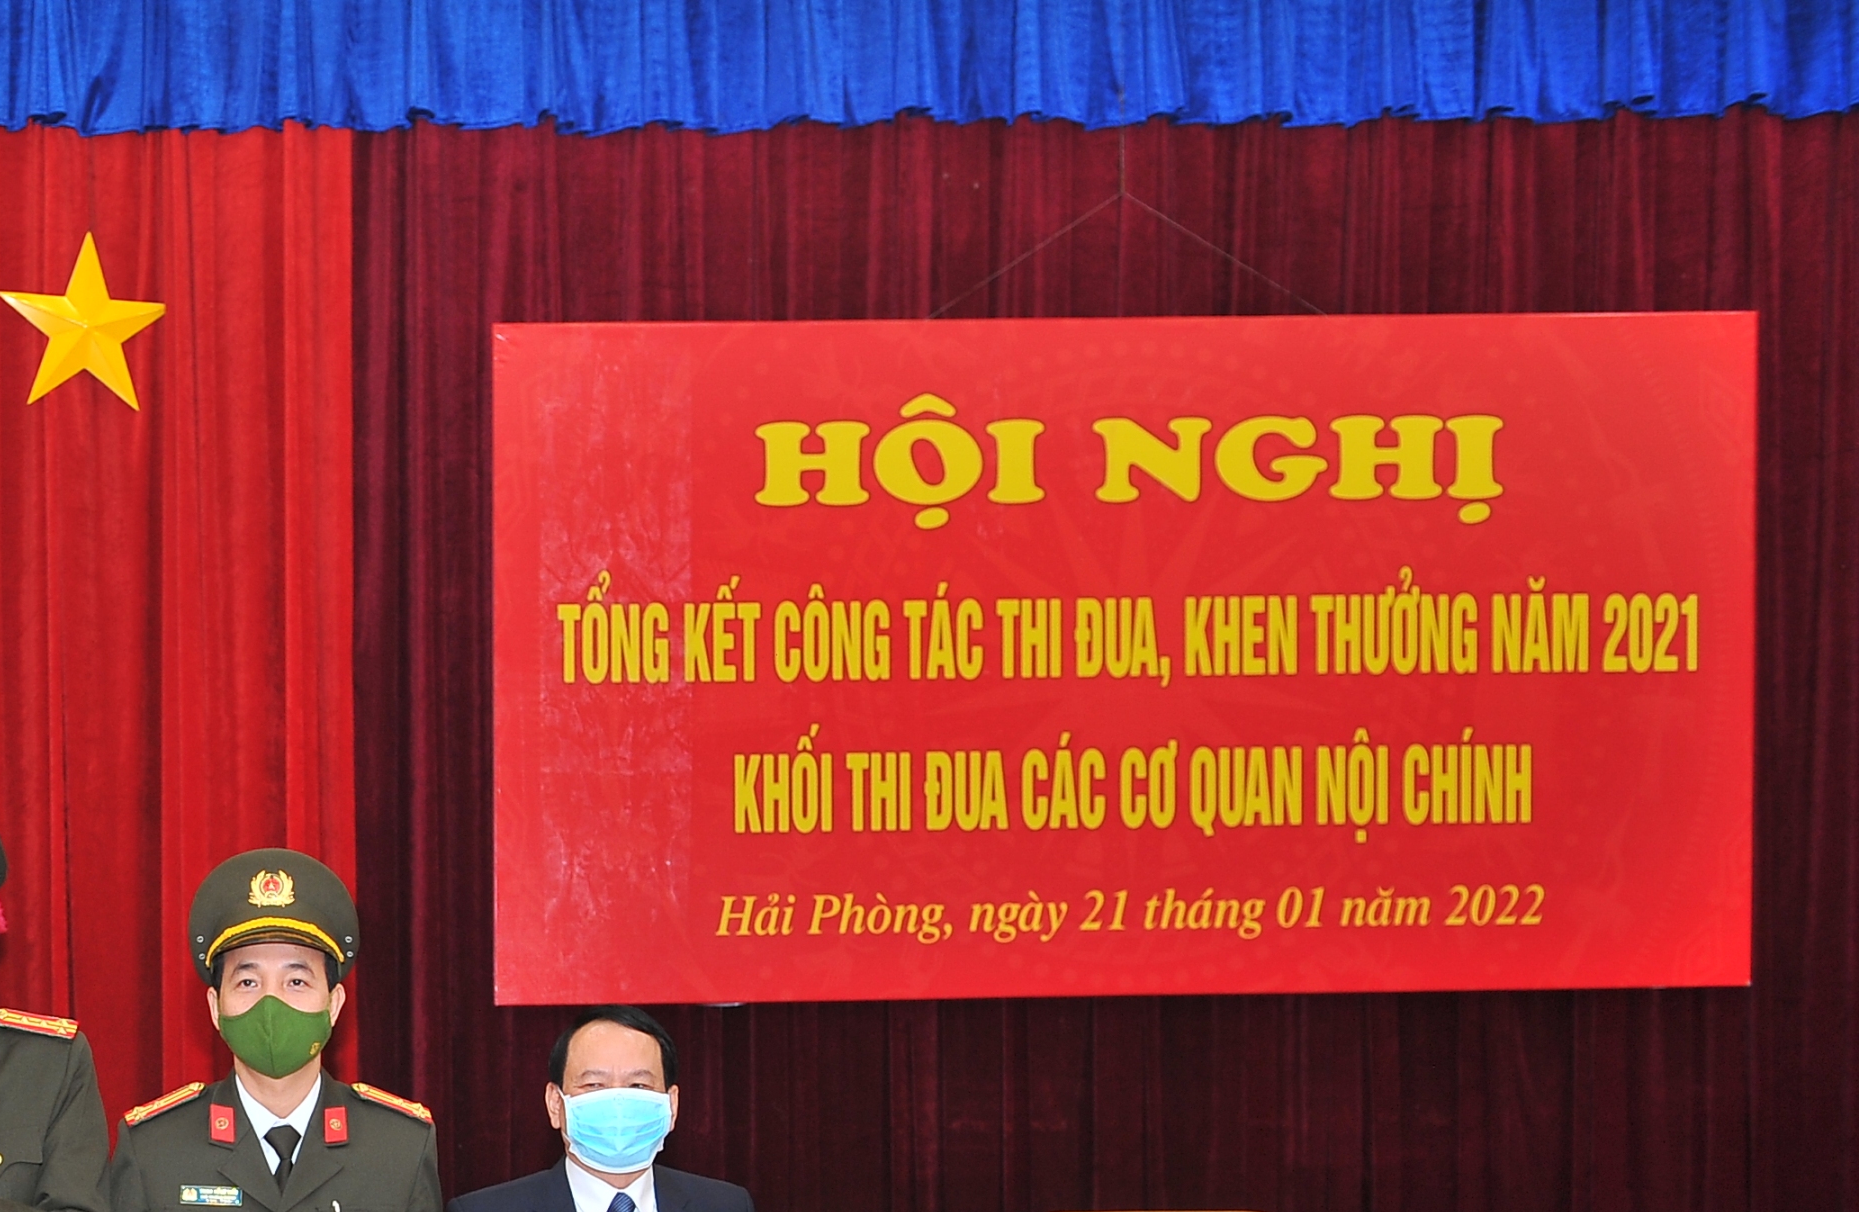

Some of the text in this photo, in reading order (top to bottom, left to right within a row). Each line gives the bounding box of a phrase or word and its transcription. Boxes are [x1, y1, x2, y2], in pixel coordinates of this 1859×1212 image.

[754, 392, 1504, 530] HỘI NGHỊ
[556, 565, 1699, 688] TỔNG KẾT CÔNG TÁC THI ĐUA, KHEN THƯỞNG NĂM 2021
[733, 722, 1533, 844] KHỐI THI ĐUA CÁC CƠ QUAN NỘI CHÍNH
[716, 883, 1546, 945] Hải Phòng, ngày 21 tháng 01 năm 2022
